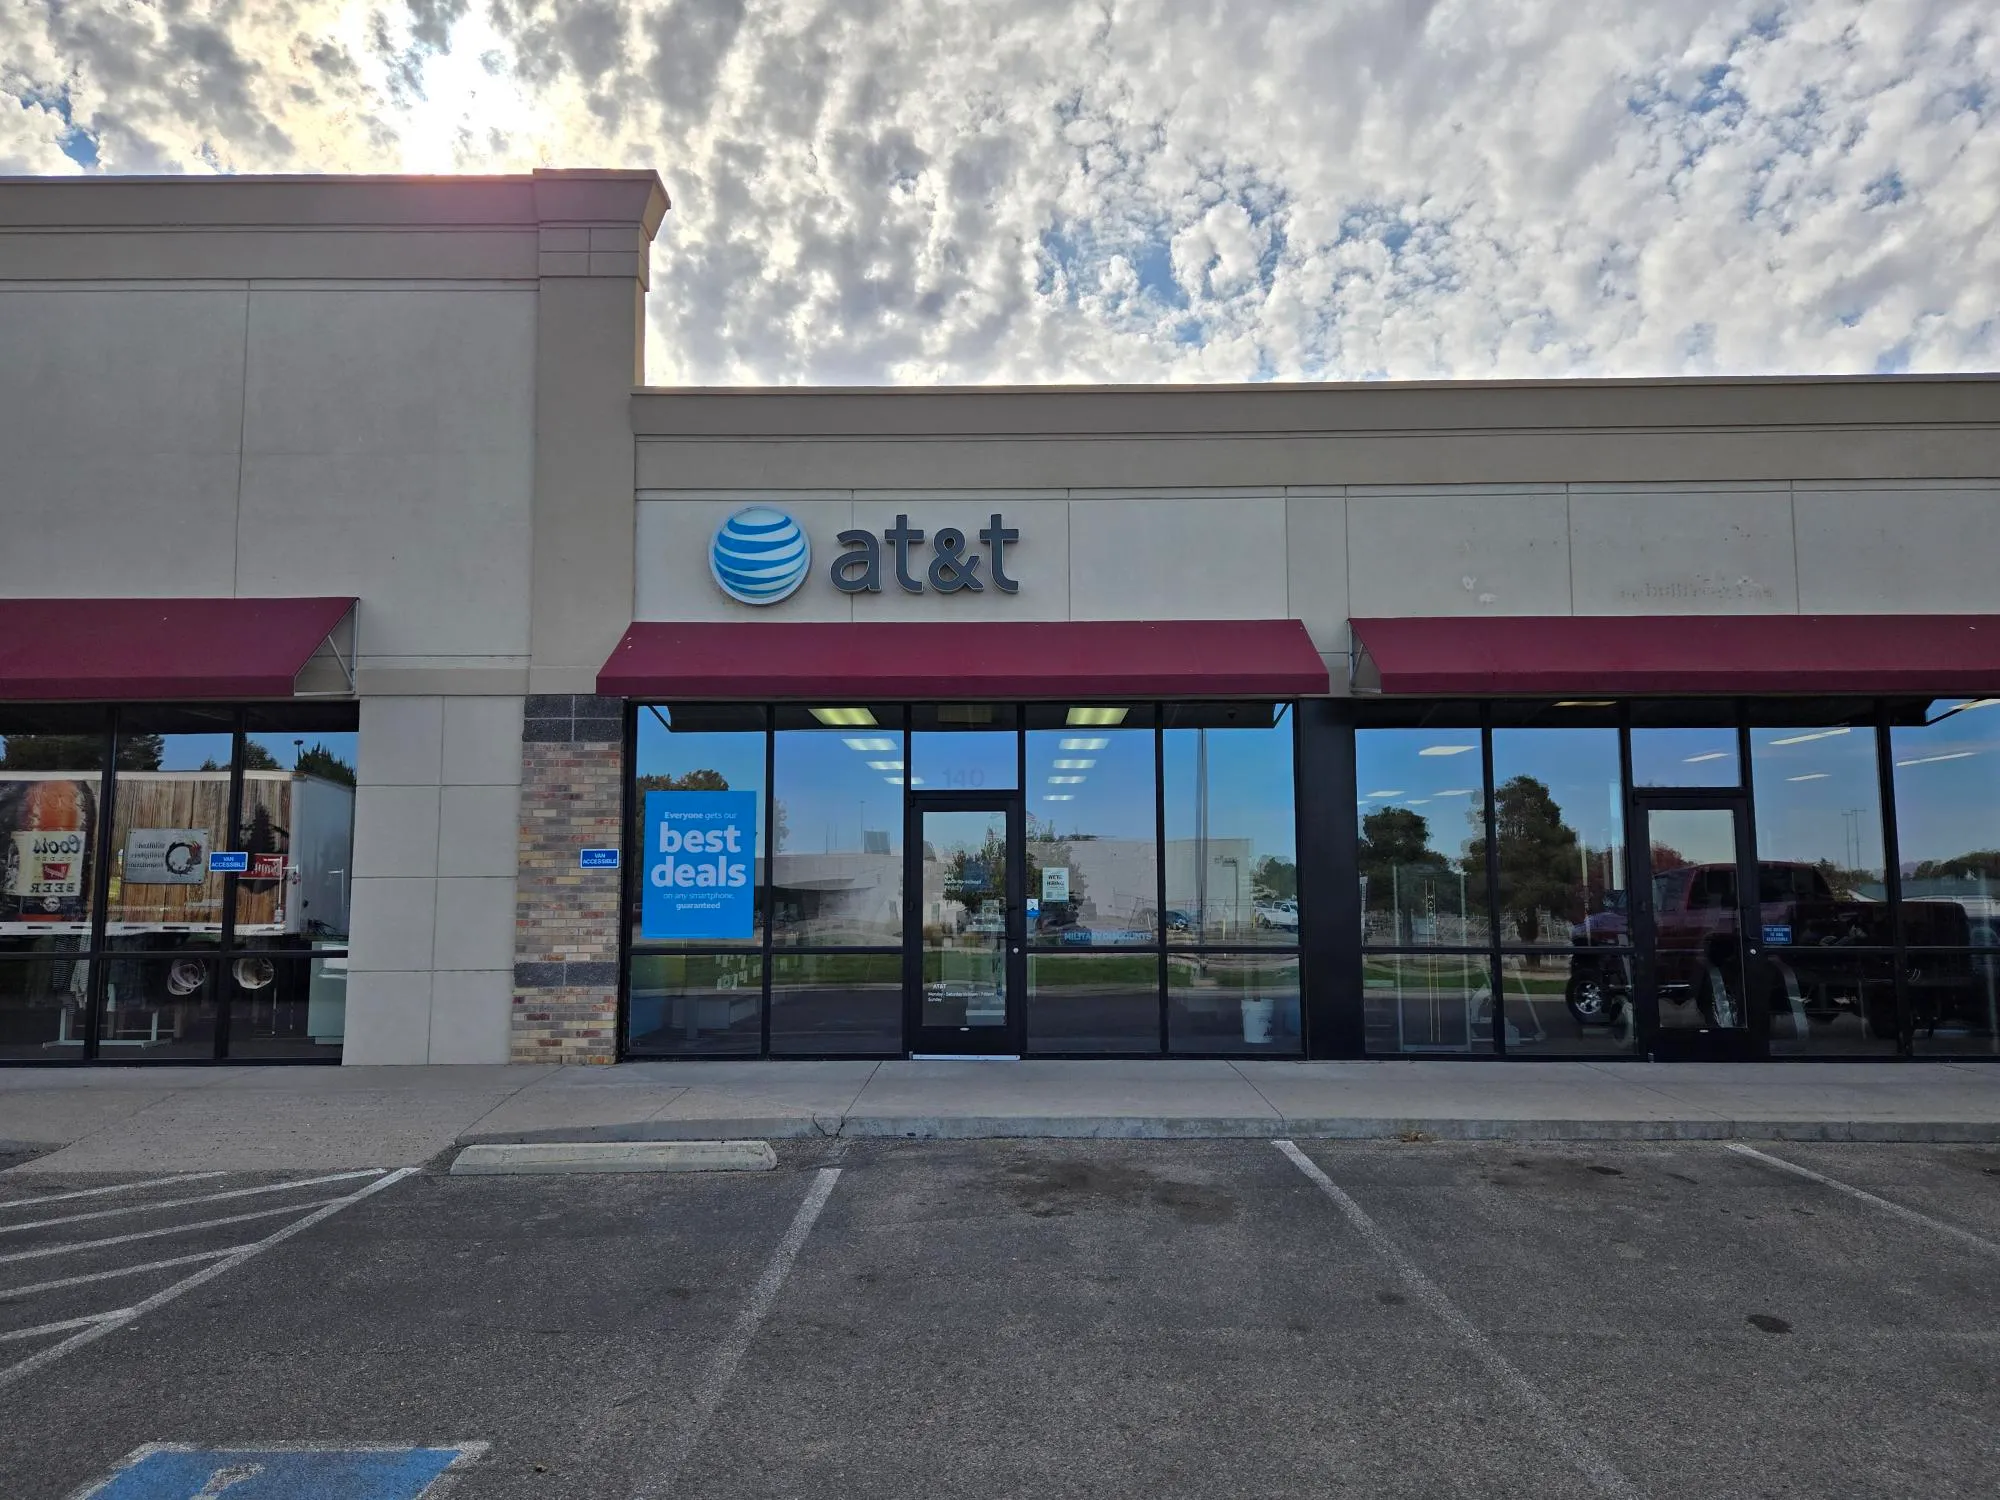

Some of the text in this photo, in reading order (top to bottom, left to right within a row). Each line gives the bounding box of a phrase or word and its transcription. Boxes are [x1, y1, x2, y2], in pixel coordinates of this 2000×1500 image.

[830, 514, 1019, 595] at&t
[942, 767, 985, 788] 140
[664, 811, 703, 820] Everyone
[705, 812, 722, 821] gets
[659, 821, 742, 853] best
[650, 855, 747, 888] deals
[676, 902, 721, 911] guaranteed
